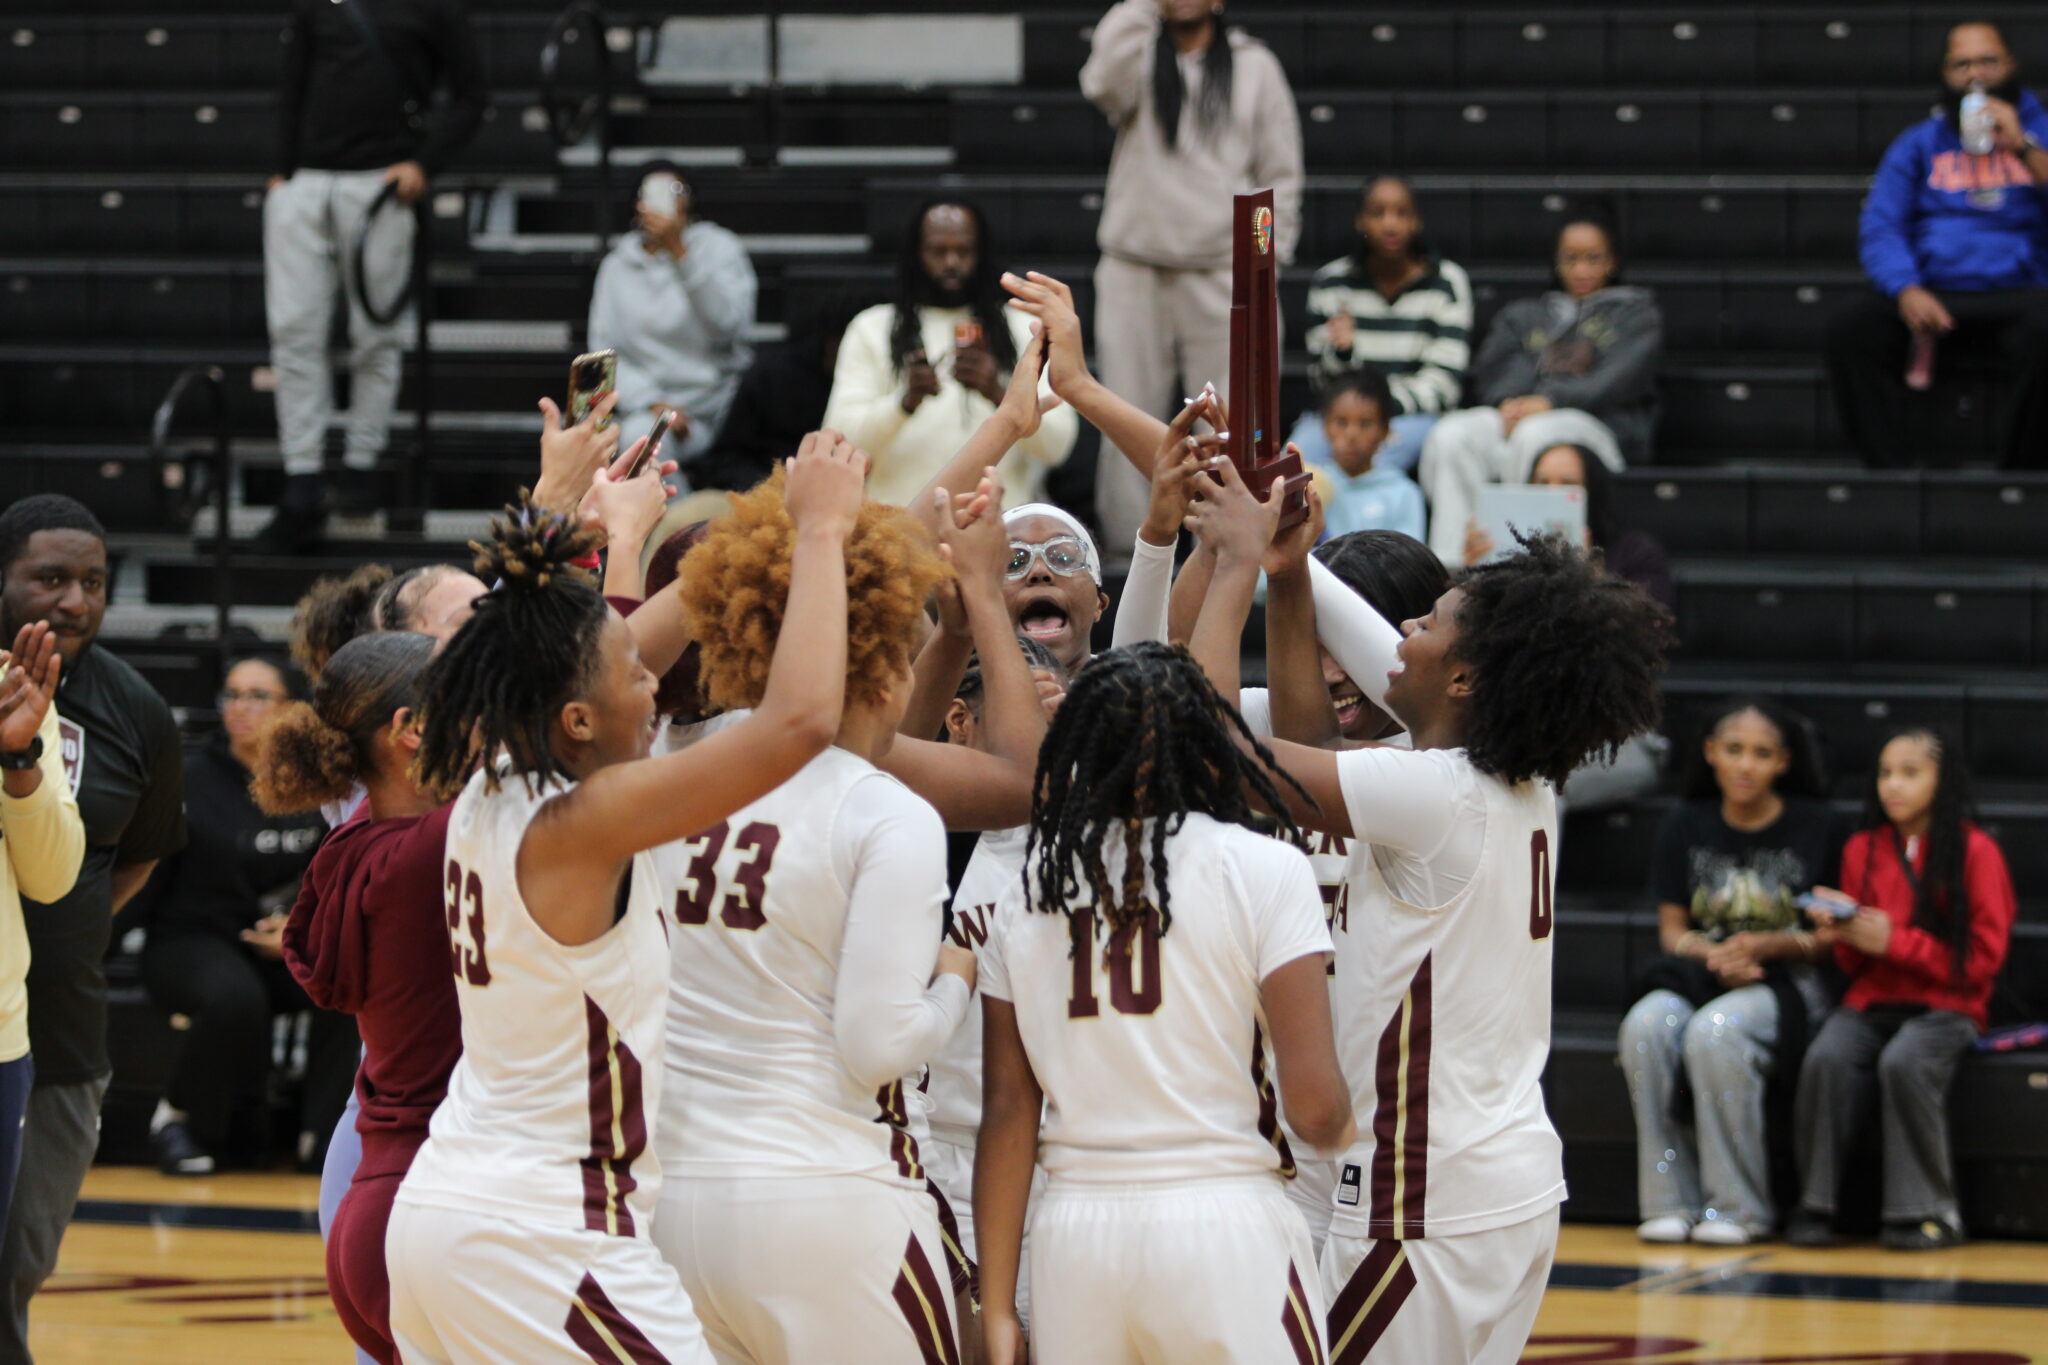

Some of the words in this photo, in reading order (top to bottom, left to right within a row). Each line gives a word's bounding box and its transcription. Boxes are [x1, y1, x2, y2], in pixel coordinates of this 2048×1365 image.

[446, 858, 492, 988] 23
[674, 819, 781, 932] 33
[1529, 827, 1552, 942] 0
[1067, 900, 1164, 1020] 10
